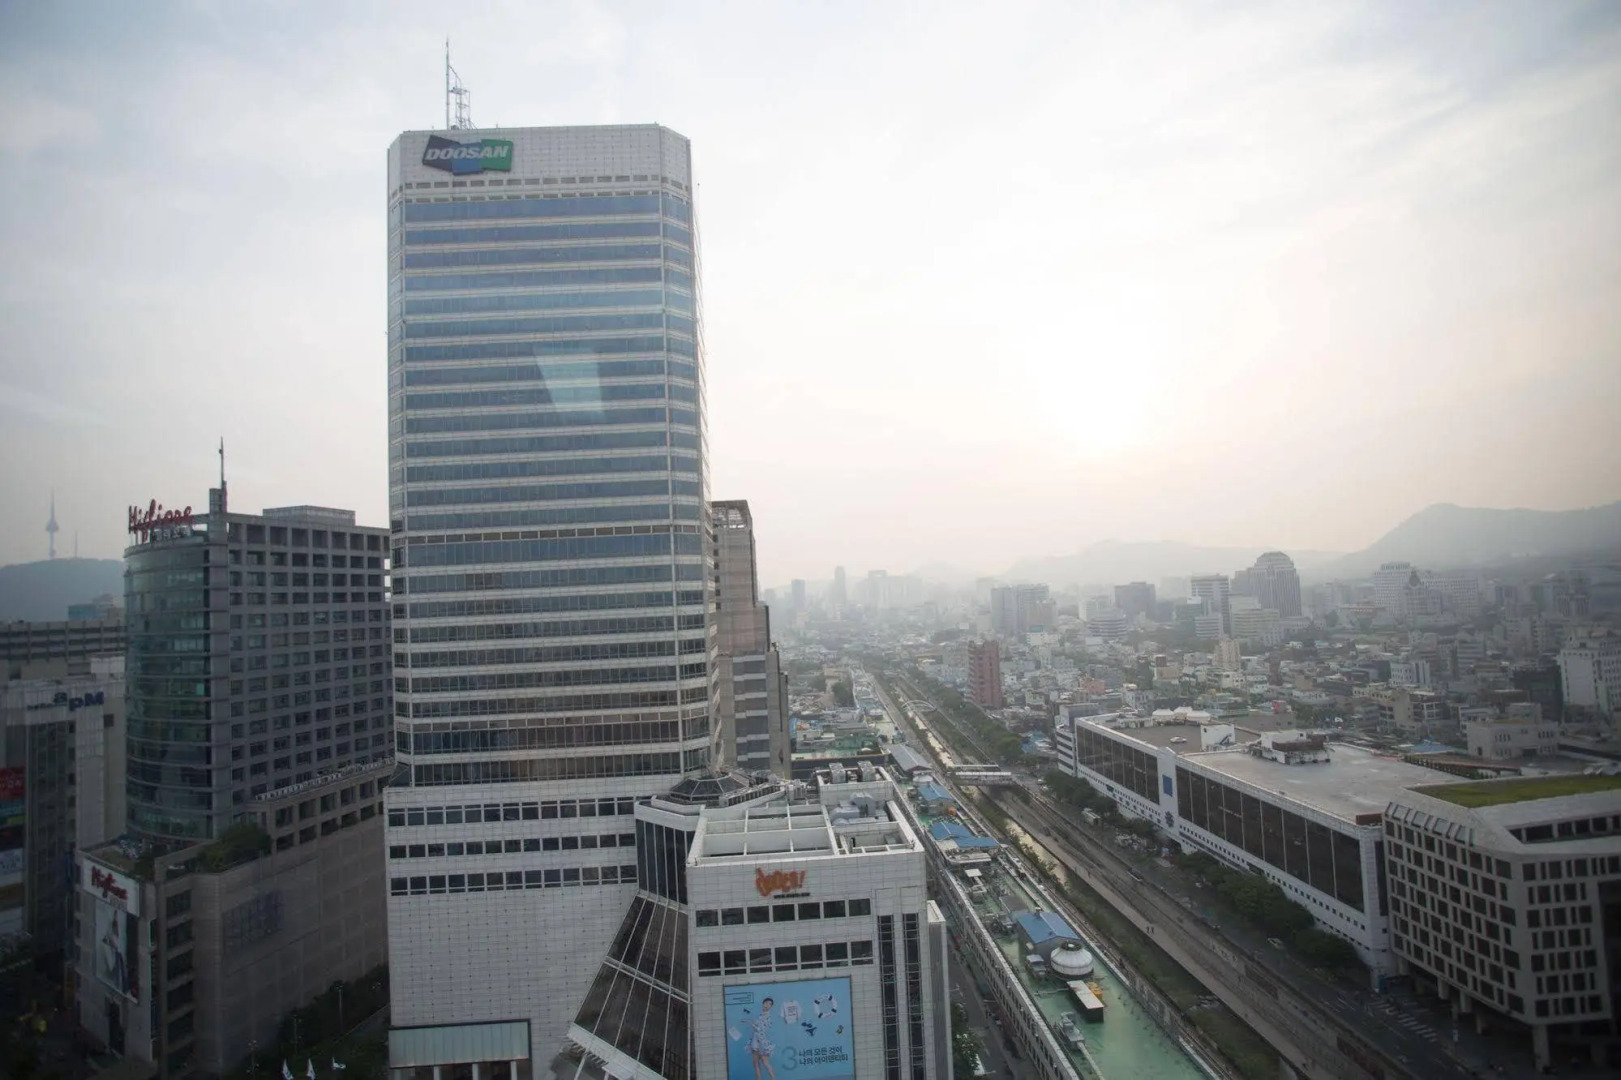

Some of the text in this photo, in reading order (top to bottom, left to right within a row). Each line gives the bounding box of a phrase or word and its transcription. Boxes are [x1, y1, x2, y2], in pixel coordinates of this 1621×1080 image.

[425, 146, 509, 160] DOOSAN
[782, 1046, 798, 1071] 3
[814, 1047, 828, 1056] 모든
